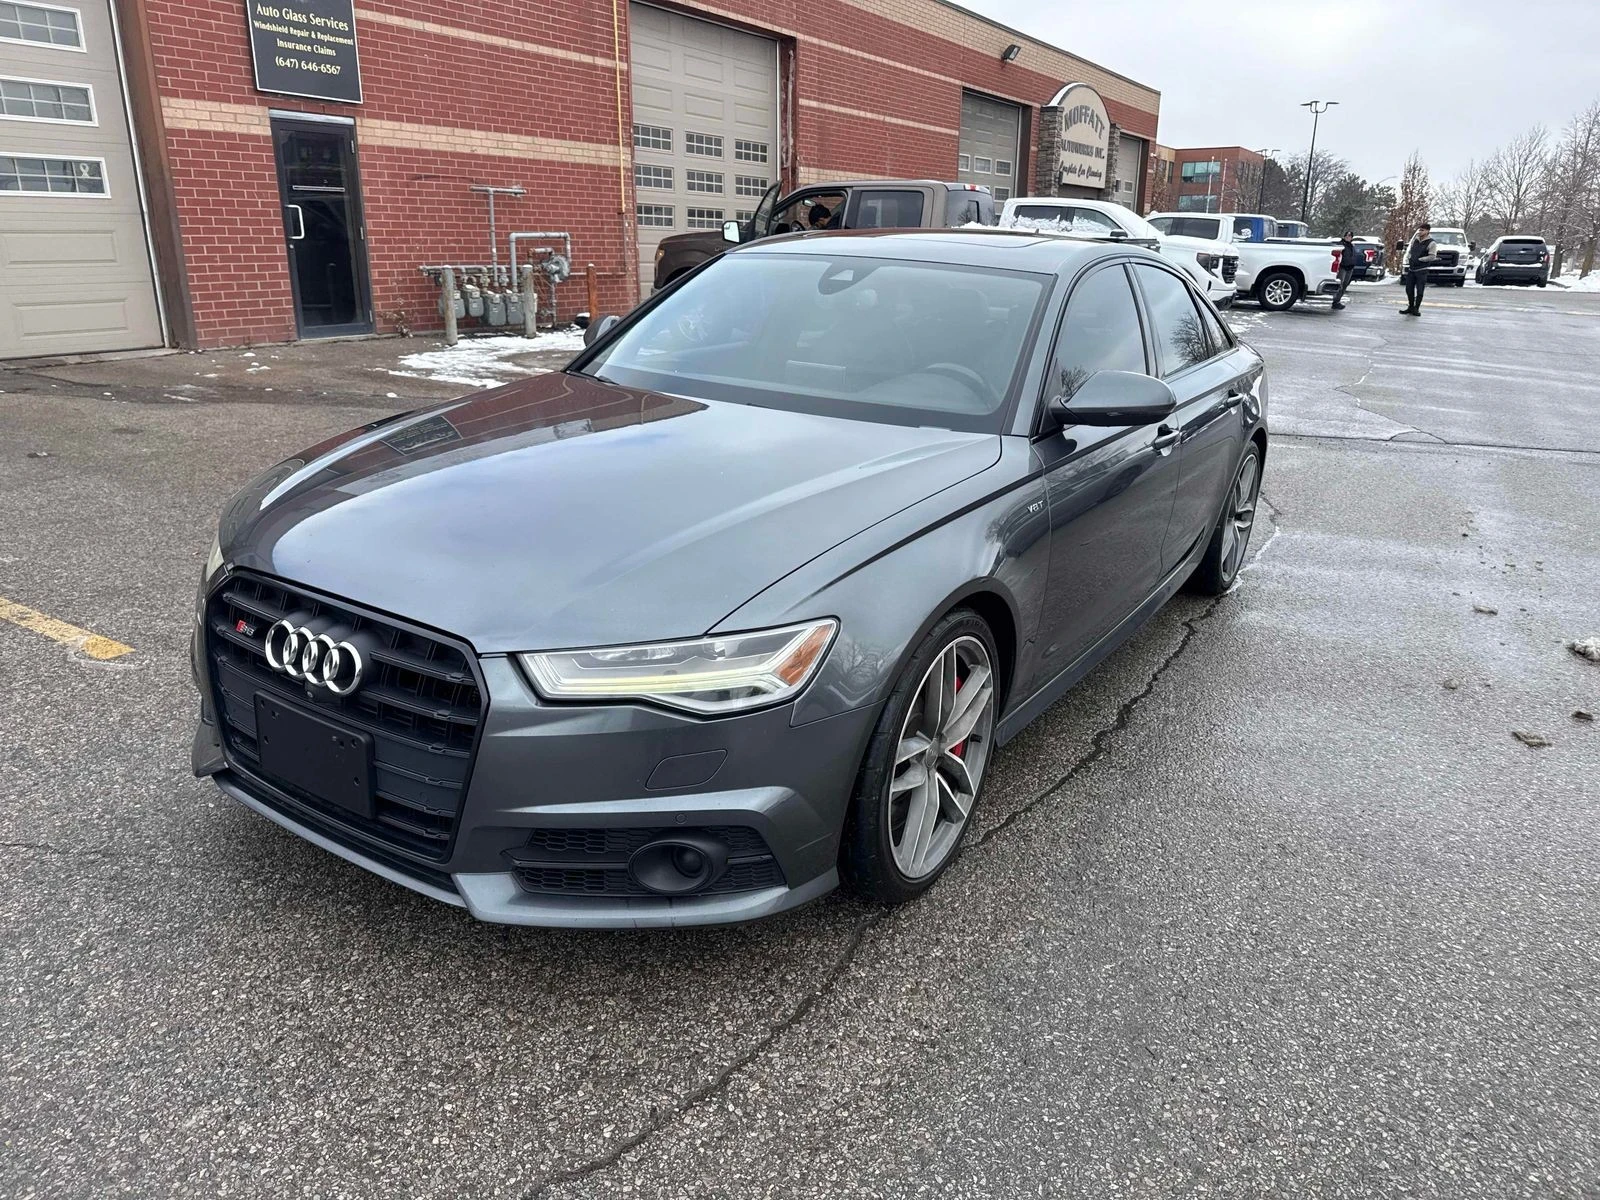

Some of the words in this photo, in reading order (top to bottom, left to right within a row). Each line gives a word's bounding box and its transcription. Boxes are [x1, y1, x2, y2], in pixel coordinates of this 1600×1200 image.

[257, 3, 279, 17] Auto
[282, 8, 307, 23] Glass
[310, 13, 348, 31] Services
[253, 20, 288, 34] Windshield
[290, 27, 309, 37] Repair
[311, 31, 316, 39] &
[317, 32, 353, 45] Replacement
[277, 38, 311, 52] Insurance
[313, 45, 336, 56] Claims
[275, 56, 298, 69] (647)
[301, 61, 340, 75] 646-6567
